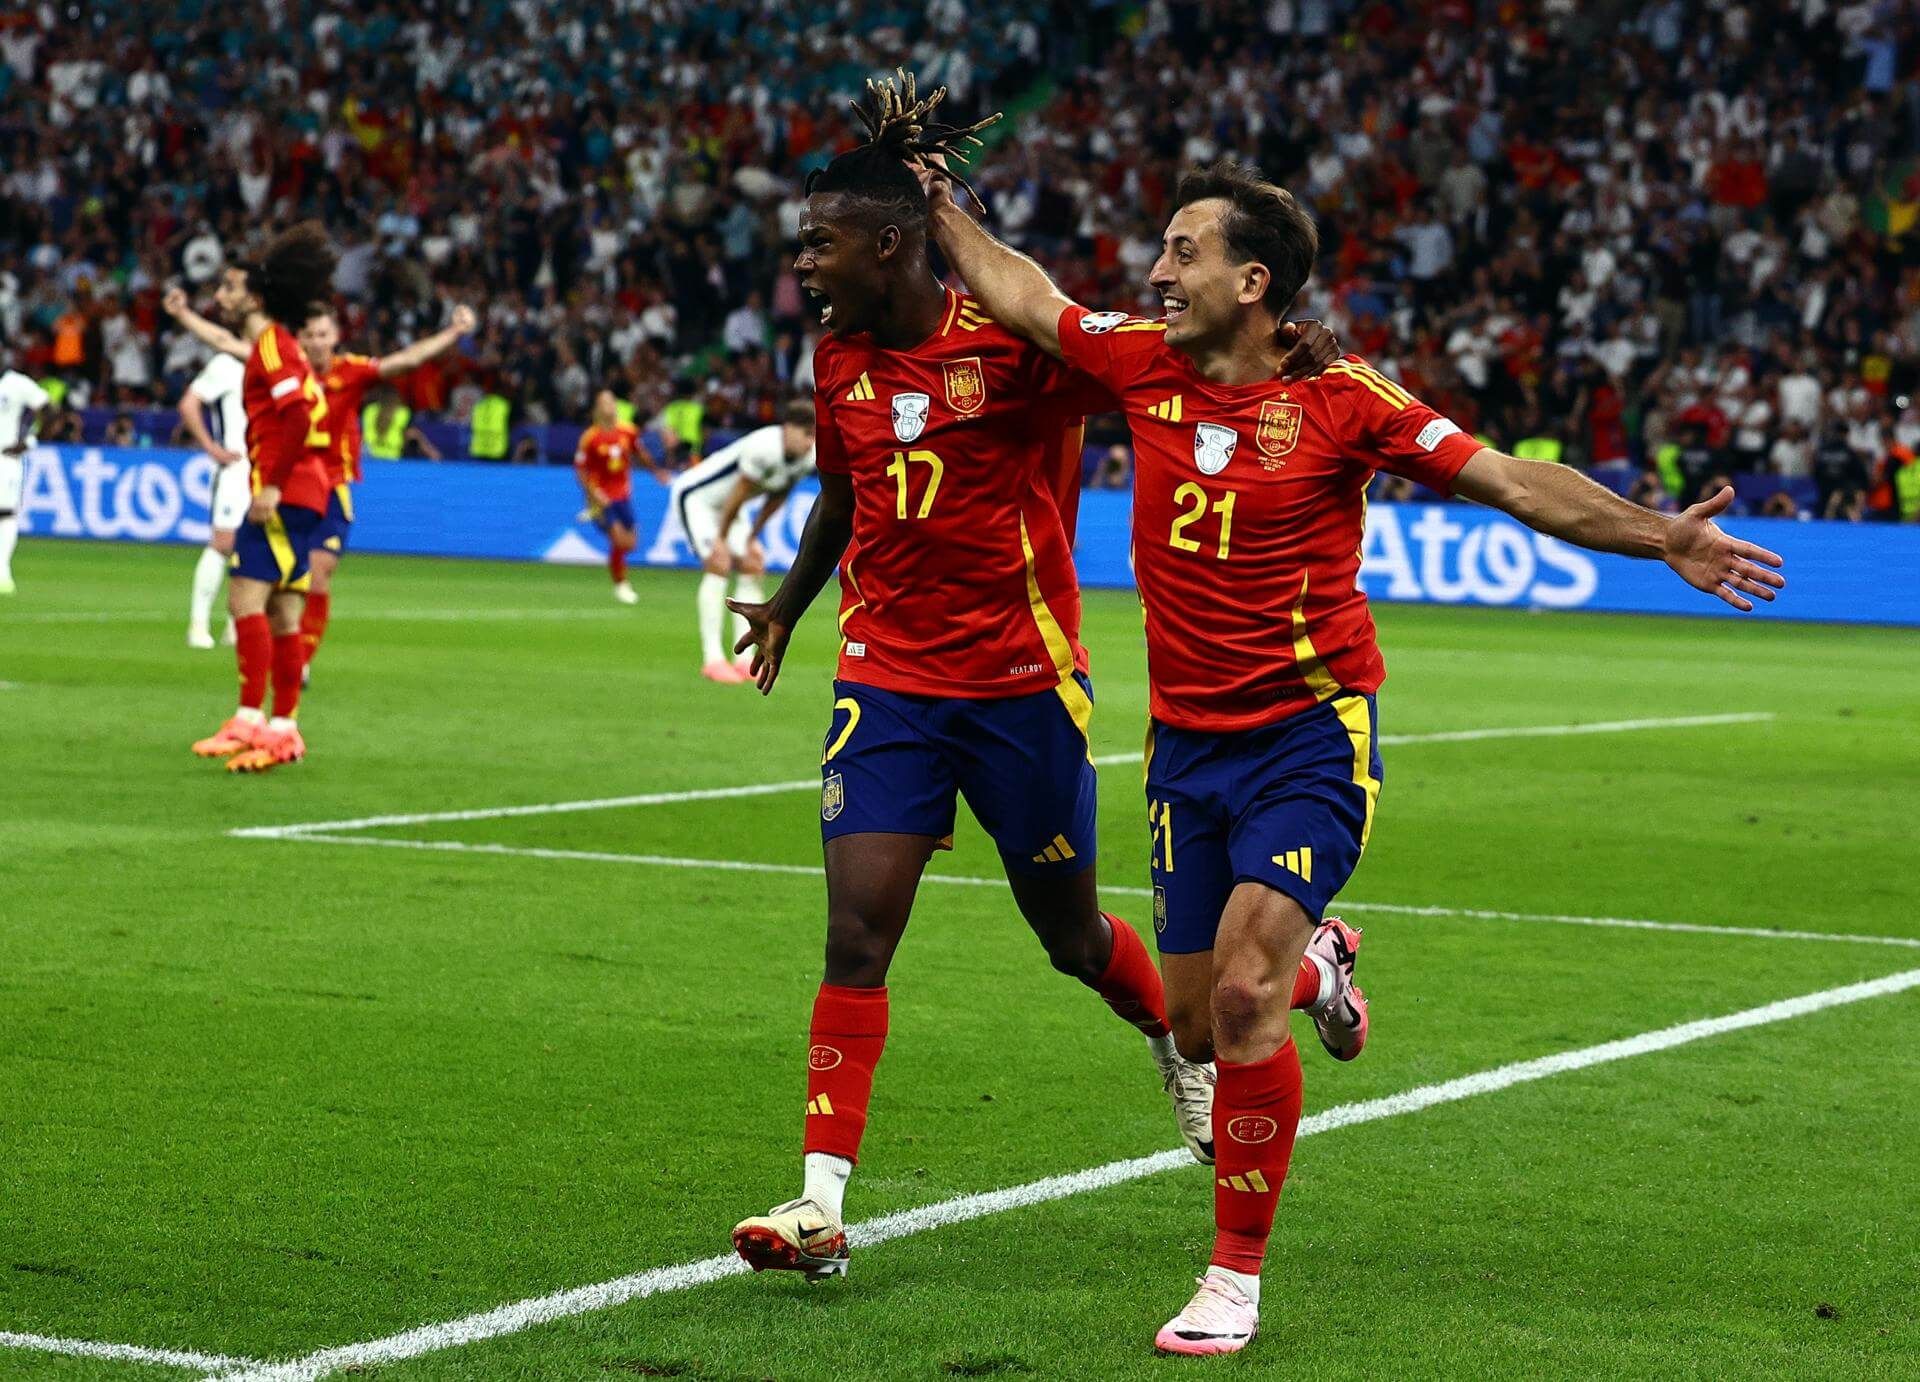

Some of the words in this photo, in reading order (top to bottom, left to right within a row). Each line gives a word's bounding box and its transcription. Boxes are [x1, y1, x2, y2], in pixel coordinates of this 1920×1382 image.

[887, 450, 944, 520] 17
[1169, 481, 1237, 560] 21
[1356, 504, 1598, 607] Atos
[1010, 663, 1043, 675] HEAT.RDY
[821, 697, 861, 766] 7
